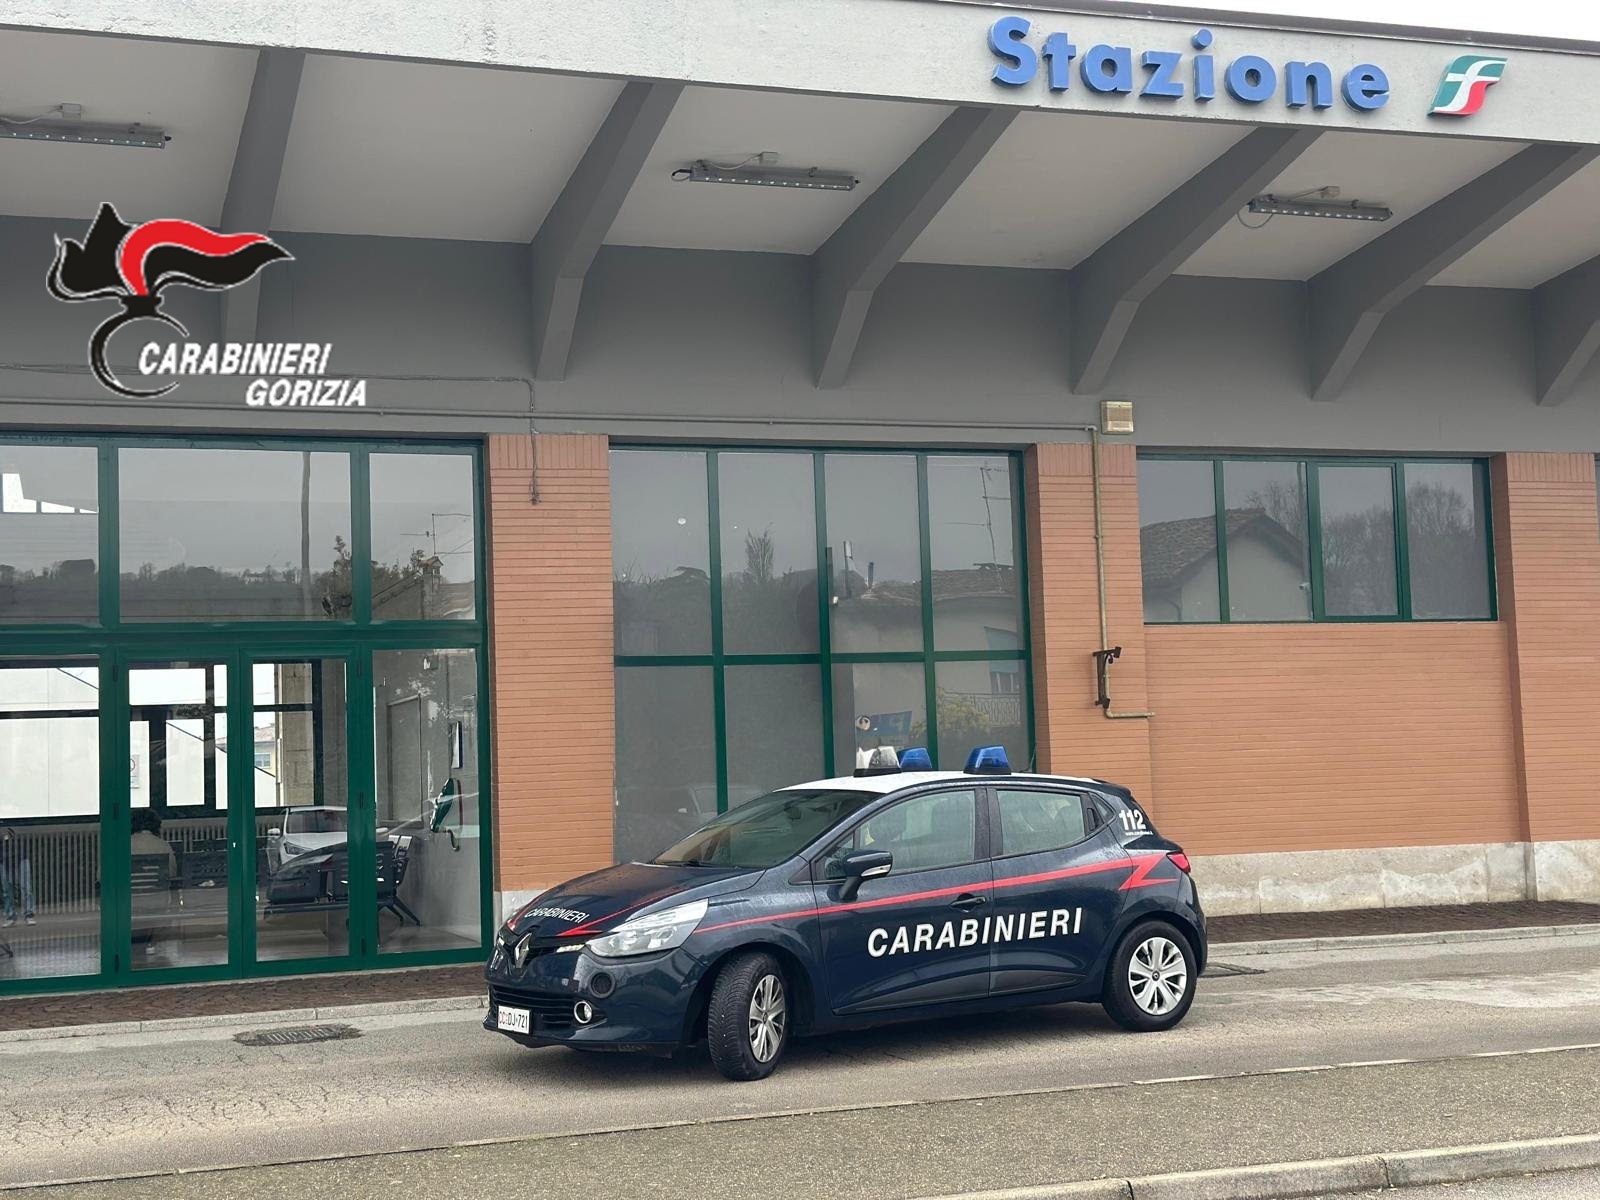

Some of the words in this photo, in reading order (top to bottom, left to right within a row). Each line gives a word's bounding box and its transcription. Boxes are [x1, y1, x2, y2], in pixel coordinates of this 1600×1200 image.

[988, 15, 1390, 111] Stazione
[1118, 809, 1147, 831] 112
[524, 907, 590, 924] CARABINIERI
[867, 907, 1083, 958] CARABINIERI
